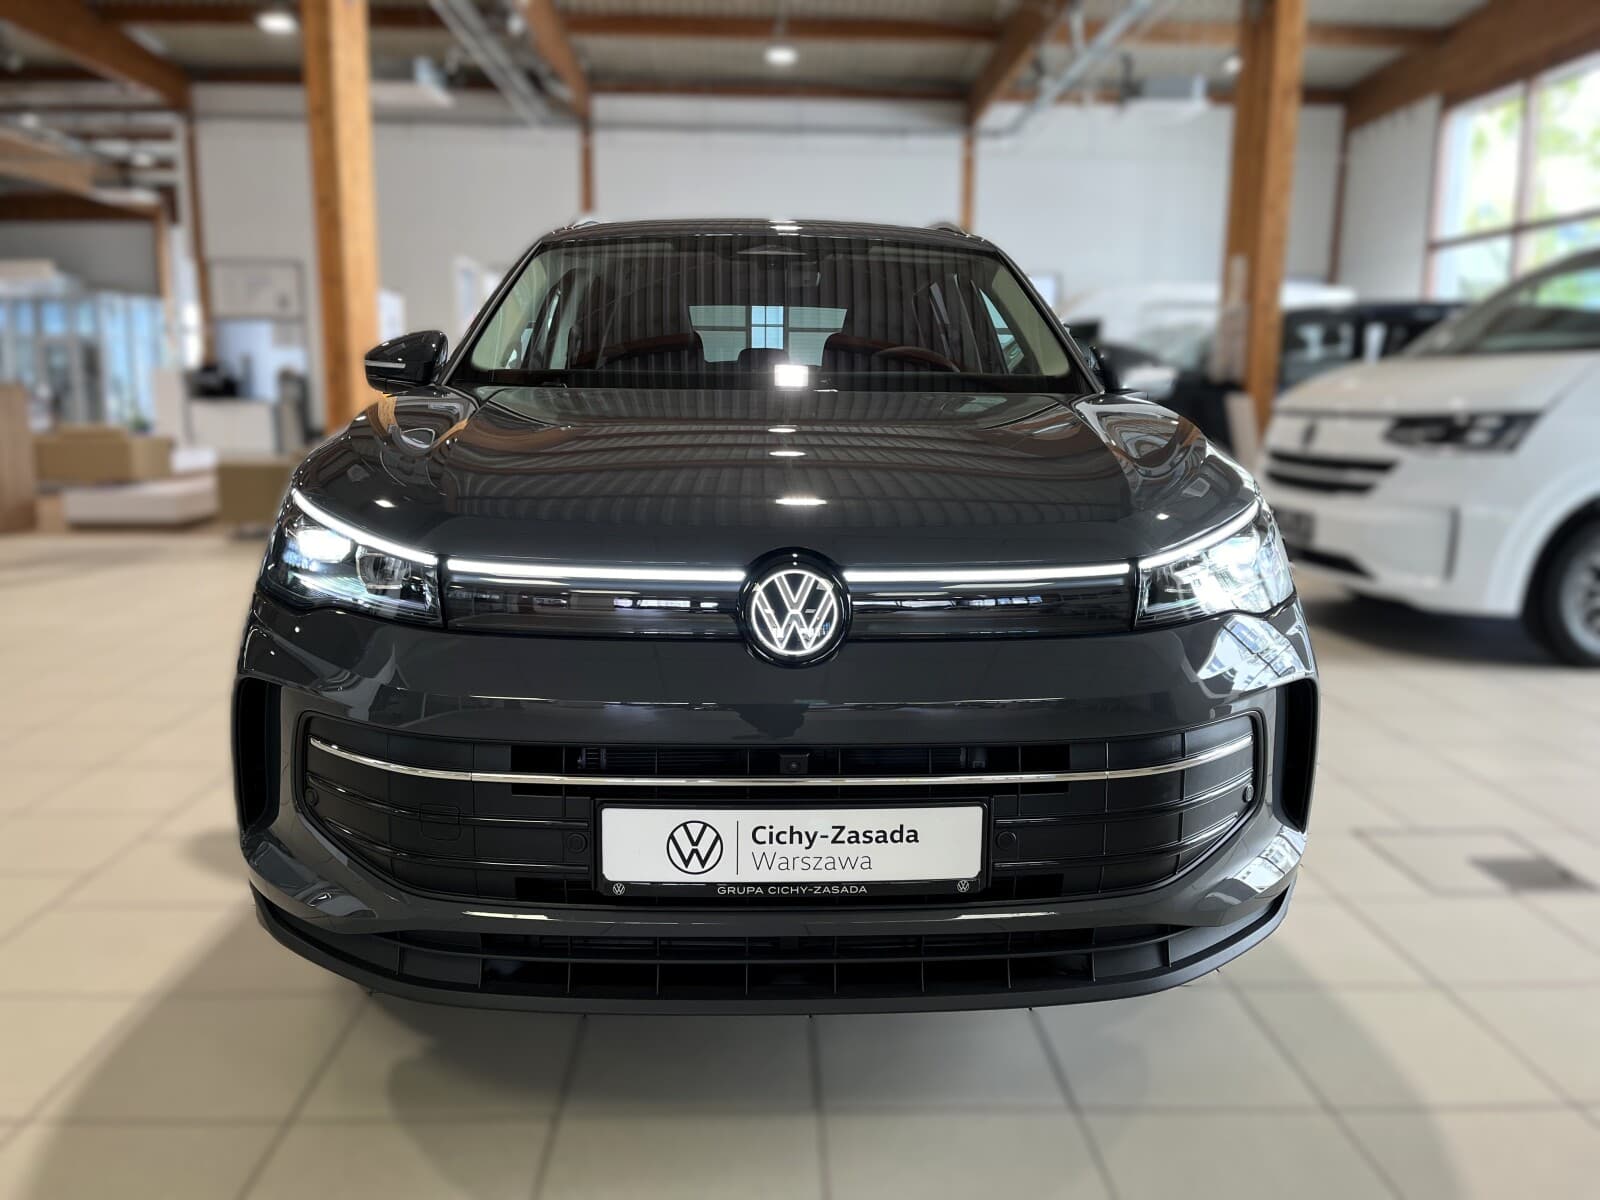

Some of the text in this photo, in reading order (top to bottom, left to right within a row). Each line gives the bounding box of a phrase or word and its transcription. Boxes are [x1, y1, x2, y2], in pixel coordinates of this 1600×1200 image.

[751, 824, 920, 850] Cichy-Zasada
[751, 851, 873, 871] Warszawa
[717, 885, 868, 895] GRUPA CICHY-ZASADA
